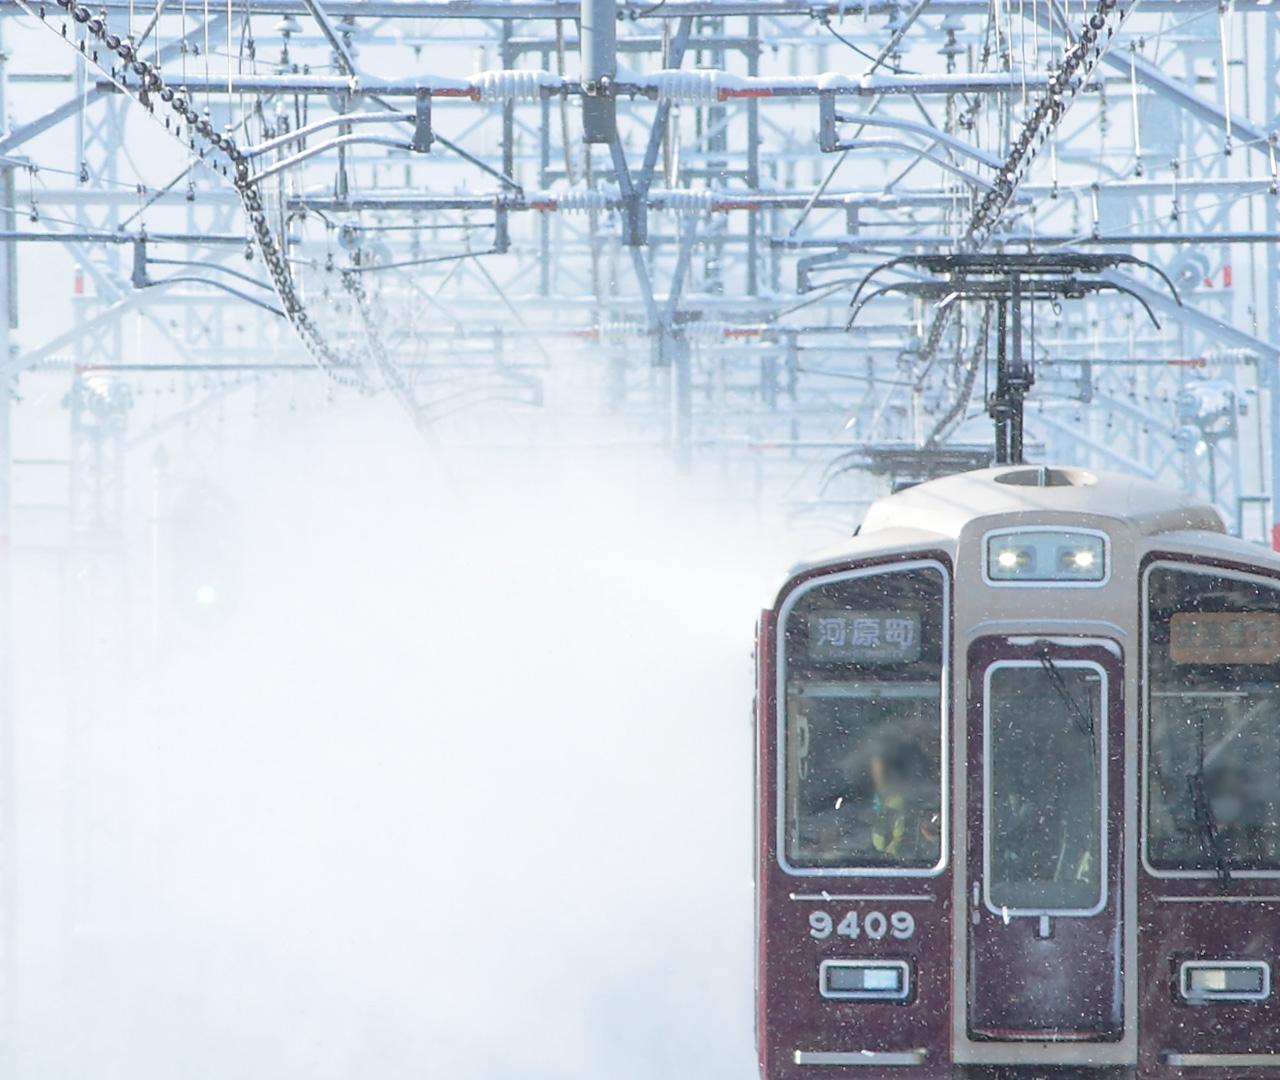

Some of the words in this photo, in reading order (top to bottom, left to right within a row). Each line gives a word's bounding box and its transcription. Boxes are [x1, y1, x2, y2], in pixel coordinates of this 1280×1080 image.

[817, 618, 914, 647] 河原町
[809, 910, 915, 940] 9409
